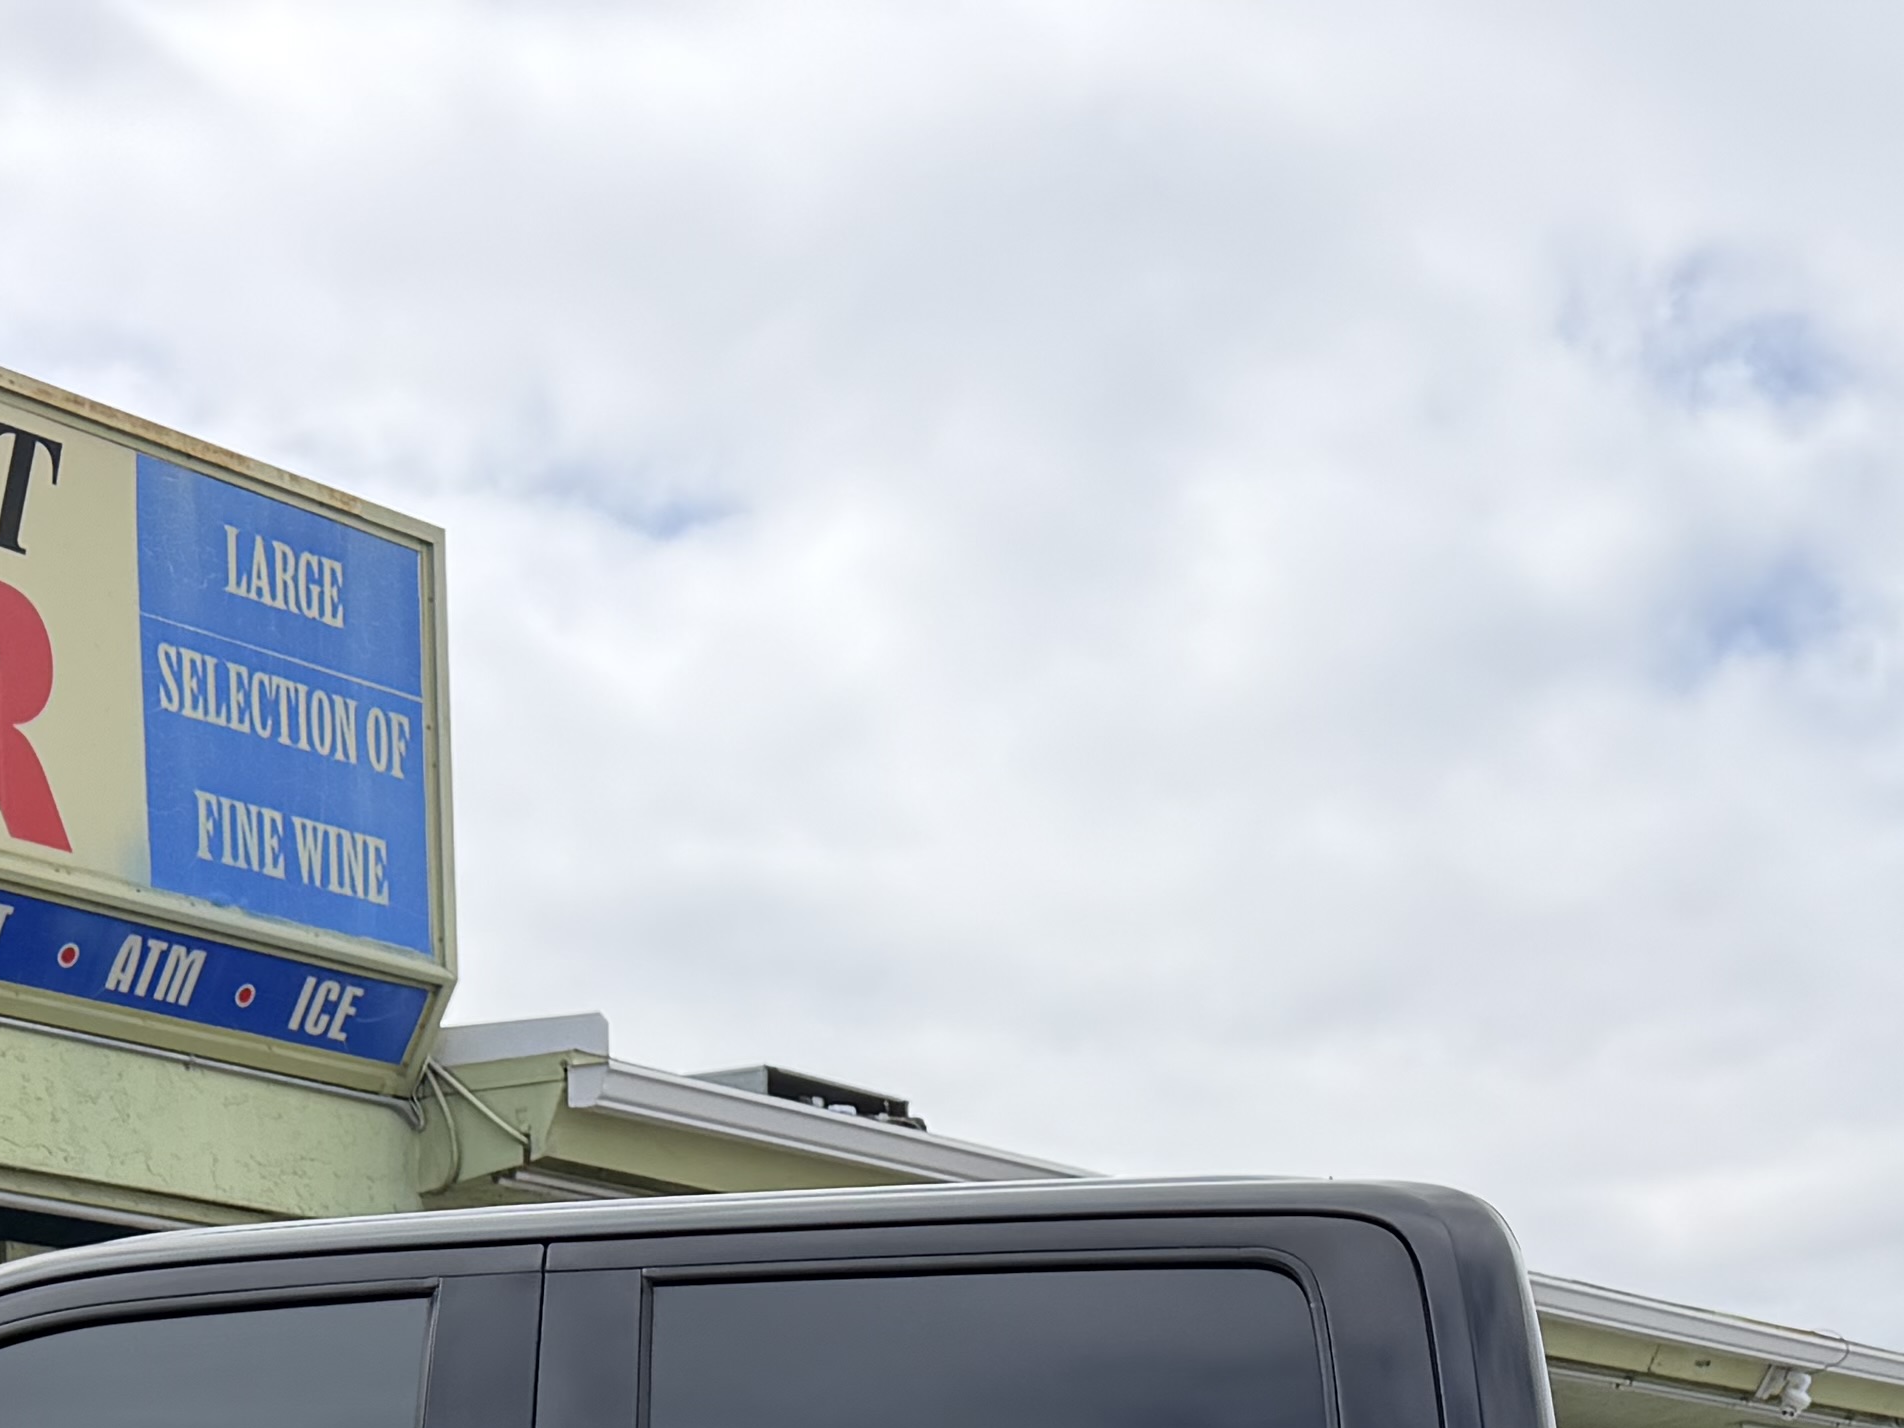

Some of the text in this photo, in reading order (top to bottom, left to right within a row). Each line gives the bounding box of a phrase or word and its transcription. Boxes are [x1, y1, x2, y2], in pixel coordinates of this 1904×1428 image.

[223, 524, 344, 628] LARGE
[156, 643, 411, 780] SELECTION OF
[194, 791, 390, 906] FINE WINE
[105, 934, 207, 1007] ATM
[286, 976, 364, 1042] ICE
